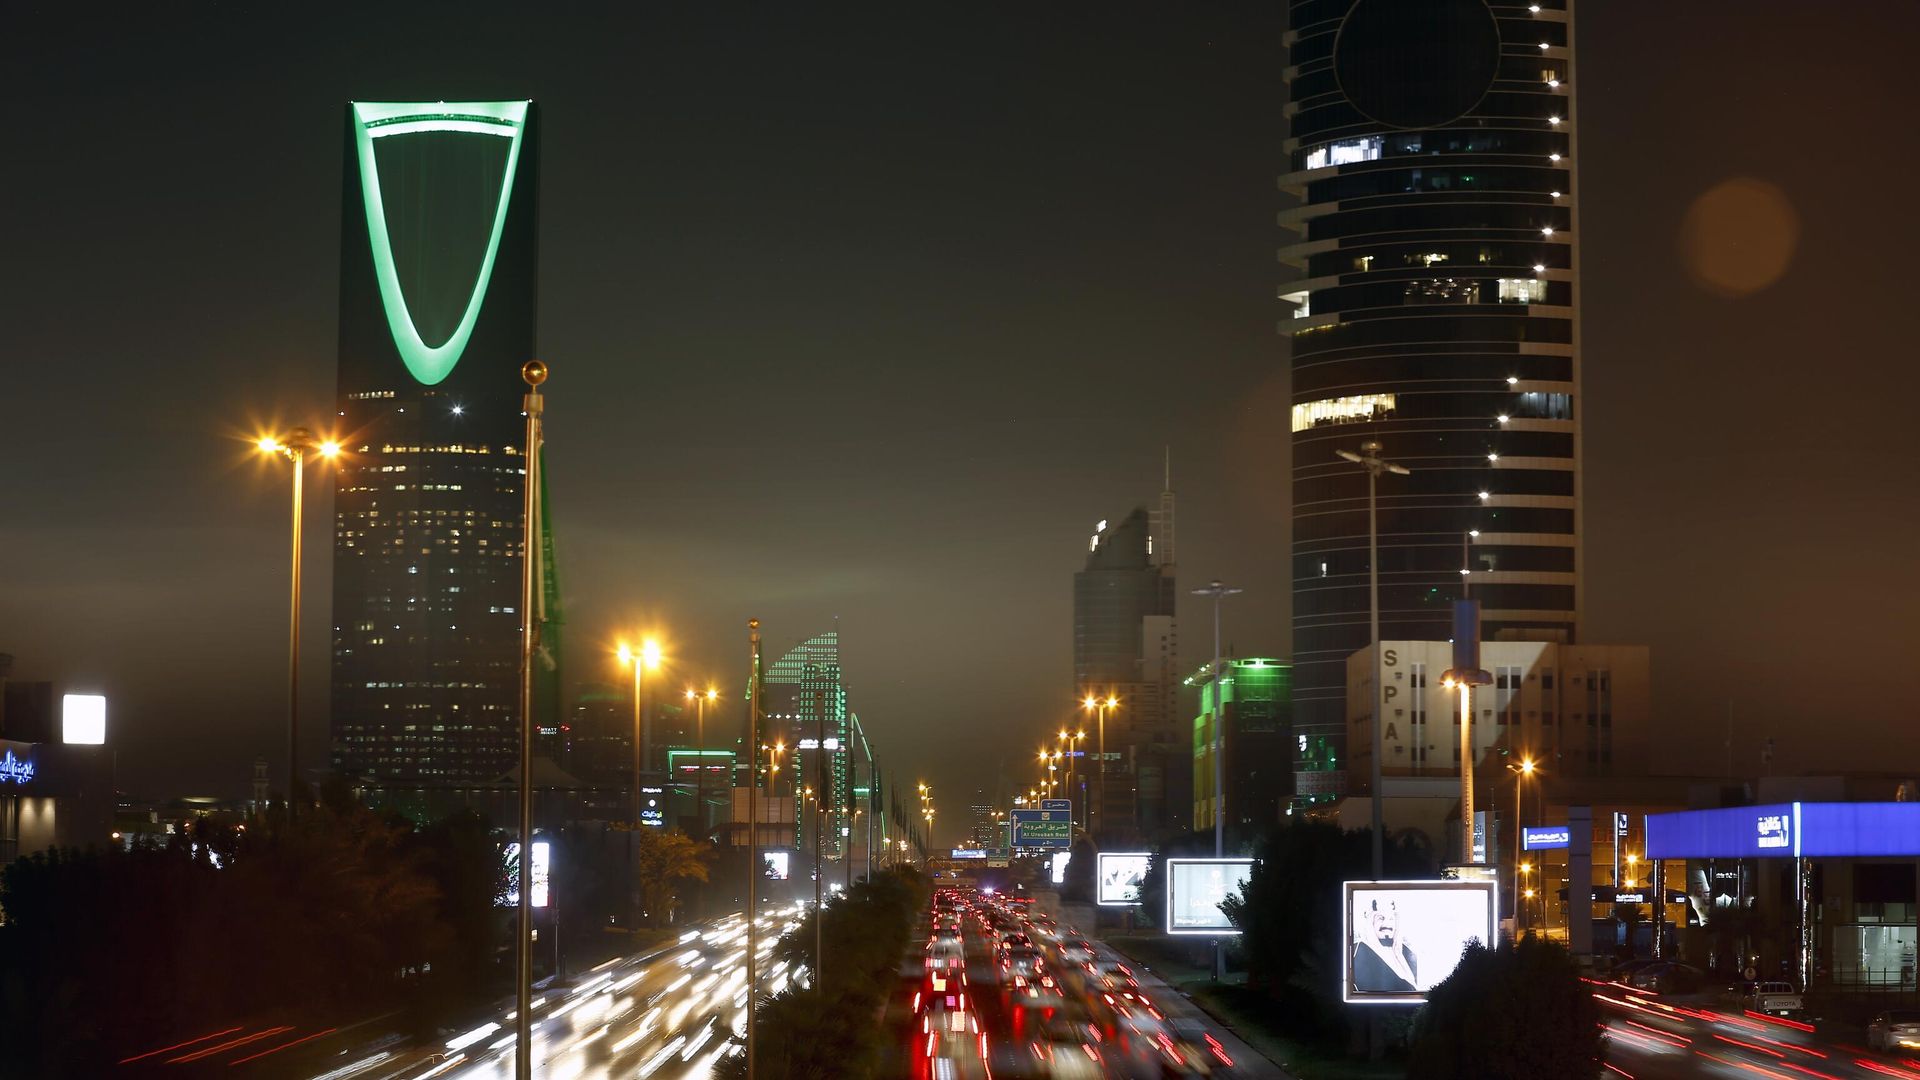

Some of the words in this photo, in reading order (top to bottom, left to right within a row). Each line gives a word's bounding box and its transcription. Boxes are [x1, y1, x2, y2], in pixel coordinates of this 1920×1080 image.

[1383, 649, 1398, 740] SPA
[1023, 823, 1047, 831] العروبة
[1047, 823, 1068, 831] طريق
